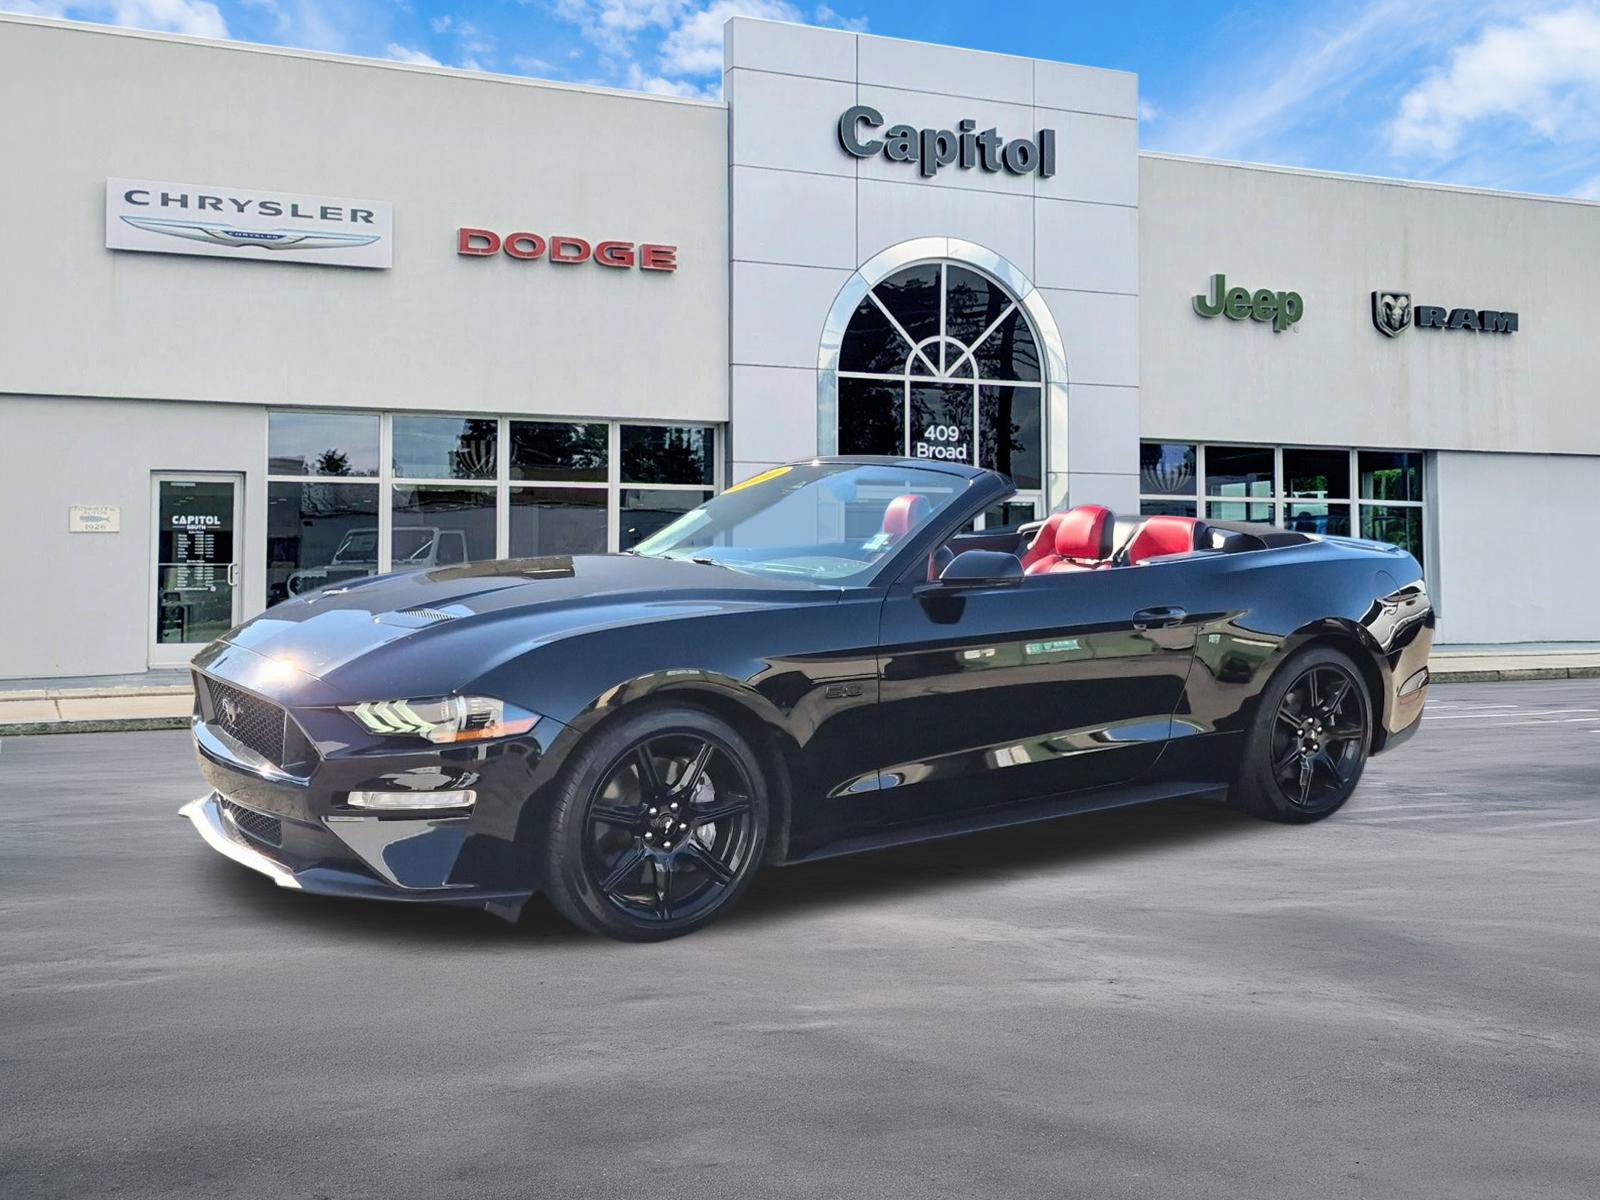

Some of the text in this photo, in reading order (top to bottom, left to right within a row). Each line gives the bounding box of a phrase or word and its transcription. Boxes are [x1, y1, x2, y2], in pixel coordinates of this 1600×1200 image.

[838, 105, 1056, 178] Capitol
[124, 189, 376, 225] CHRYSLER
[457, 227, 678, 272] DODGE
[1192, 273, 1304, 333] Jeep
[1414, 304, 1519, 334] RAM
[924, 425, 959, 442] 409
[916, 442, 967, 460] Broad
[171, 515, 221, 525] CAPITOL
